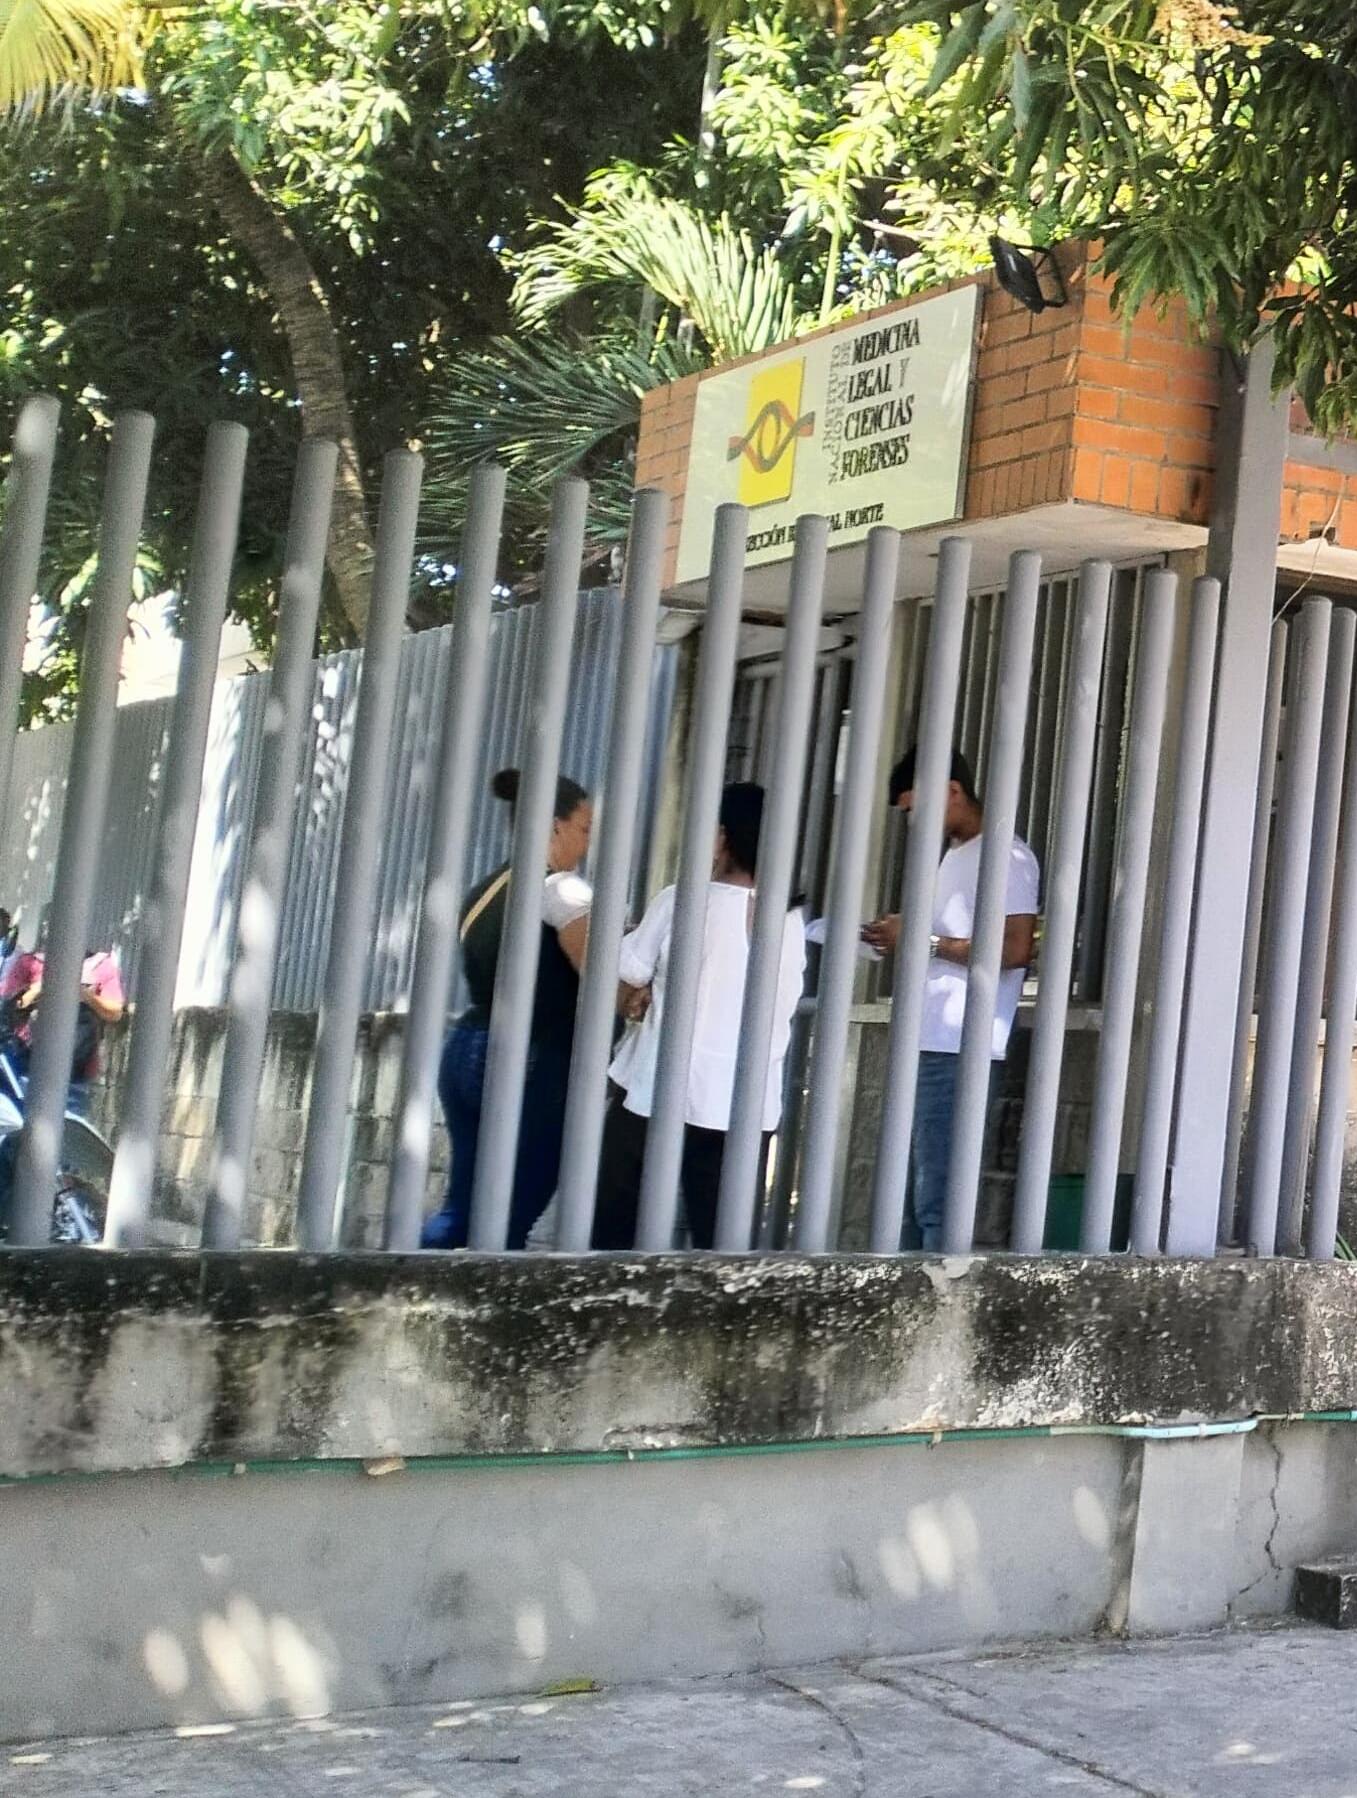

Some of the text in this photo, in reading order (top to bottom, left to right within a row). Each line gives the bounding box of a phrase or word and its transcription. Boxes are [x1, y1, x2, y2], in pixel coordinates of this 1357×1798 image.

[852, 317, 920, 366] MEDICINA
[822, 344, 841, 452] INSTITUTO
[848, 357, 910, 403] LEGAL Y
[828, 376, 848, 485] NACIONAL
[844, 394, 915, 442] CIENCIAS
[840, 433, 911, 481] FORENSES
[844, 502, 885, 529] NORTE
